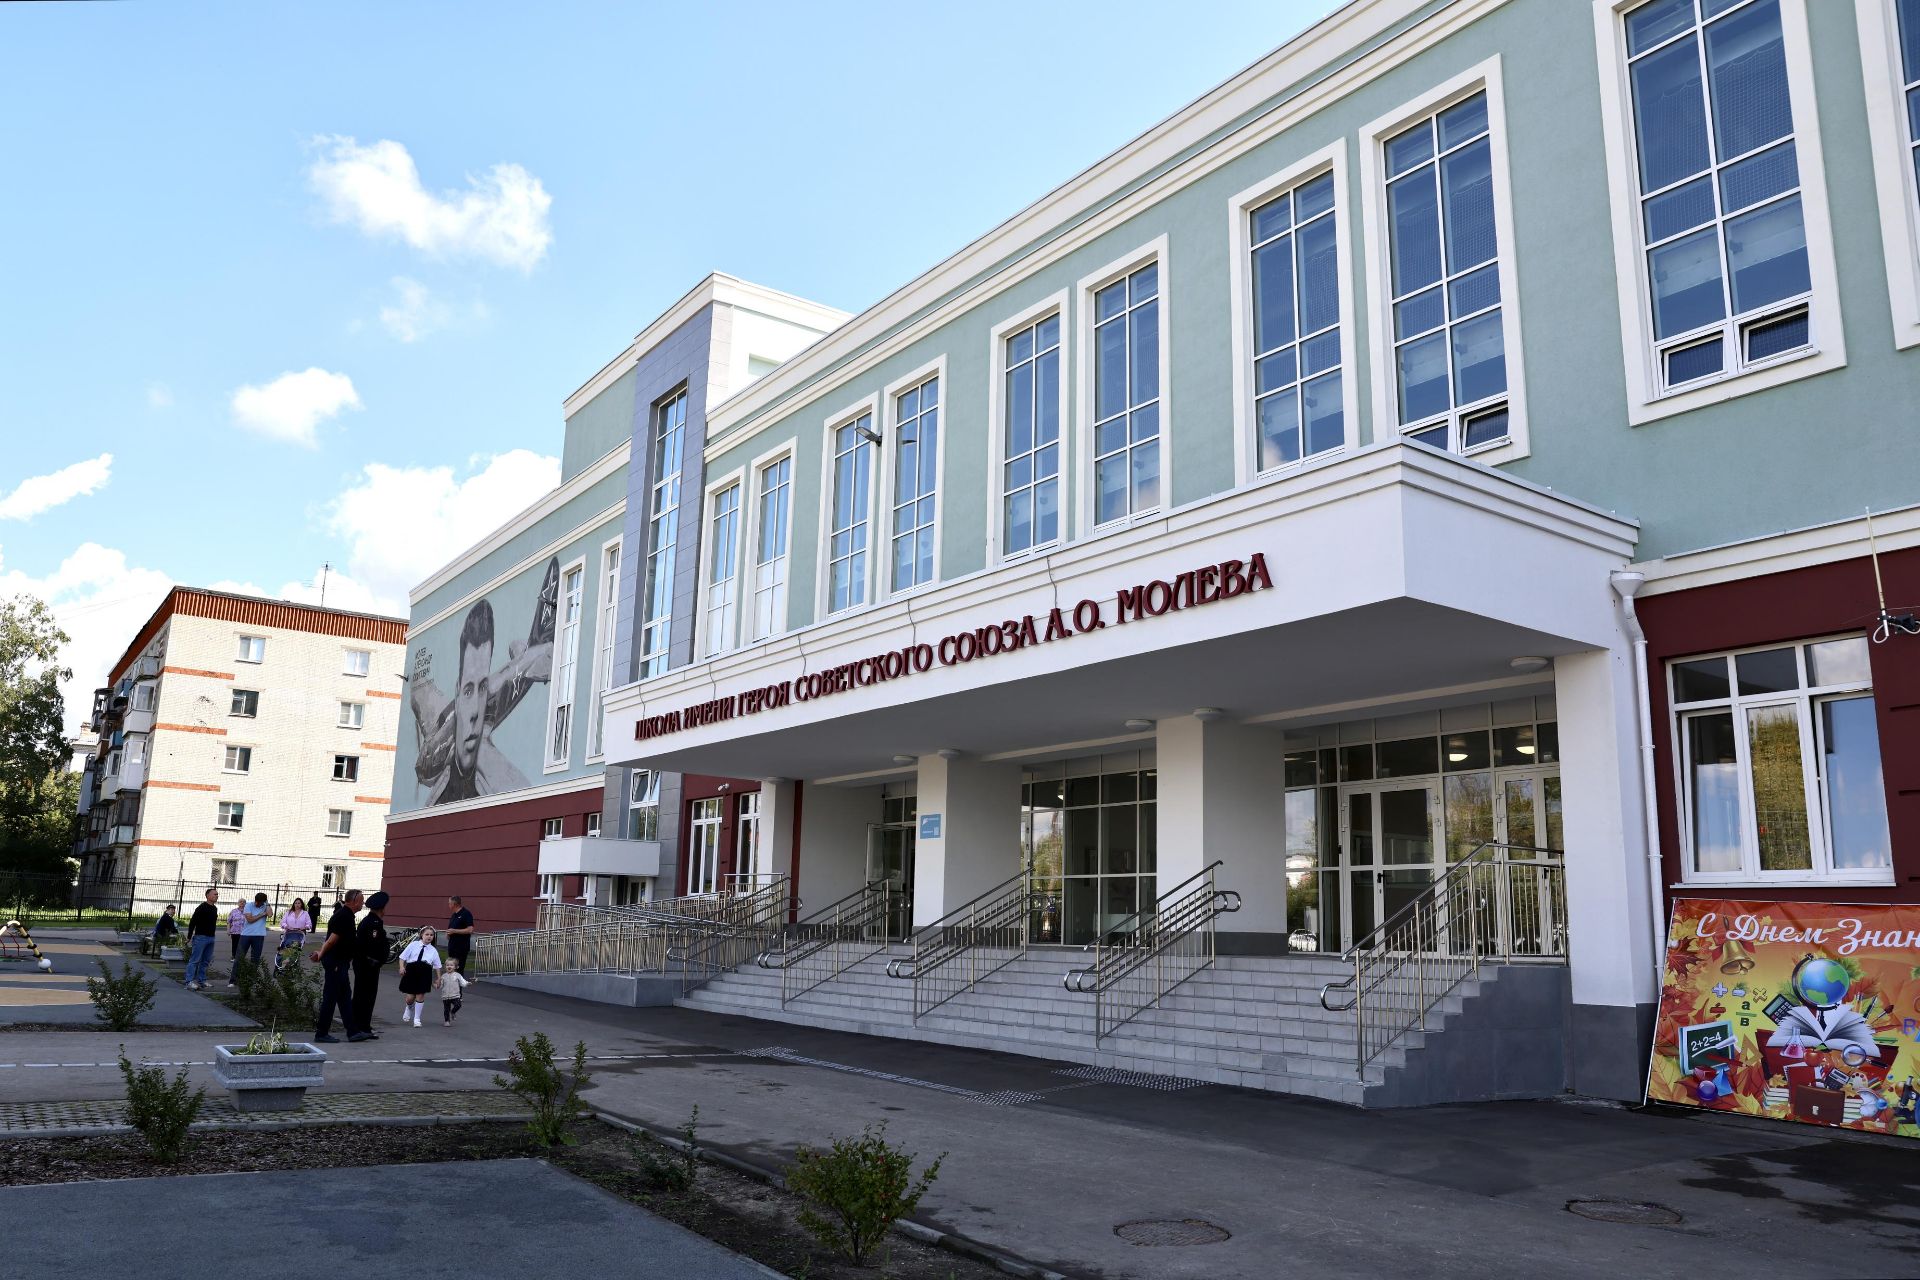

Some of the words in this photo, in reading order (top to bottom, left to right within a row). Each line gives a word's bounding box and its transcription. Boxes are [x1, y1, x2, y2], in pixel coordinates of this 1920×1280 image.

[634, 710, 682, 741] ШКОЛА
[682, 695, 735, 730] ИМЕНИ
[736, 680, 791, 716] ГЕРОЯ
[794, 643, 933, 702] СОВЕТСКОГО
[938, 615, 1037, 666] СОЮЗА
[1116, 552, 1274, 624] МОЛЕВА
[1695, 912, 1716, 938] С
[1726, 914, 1828, 944] Днем
